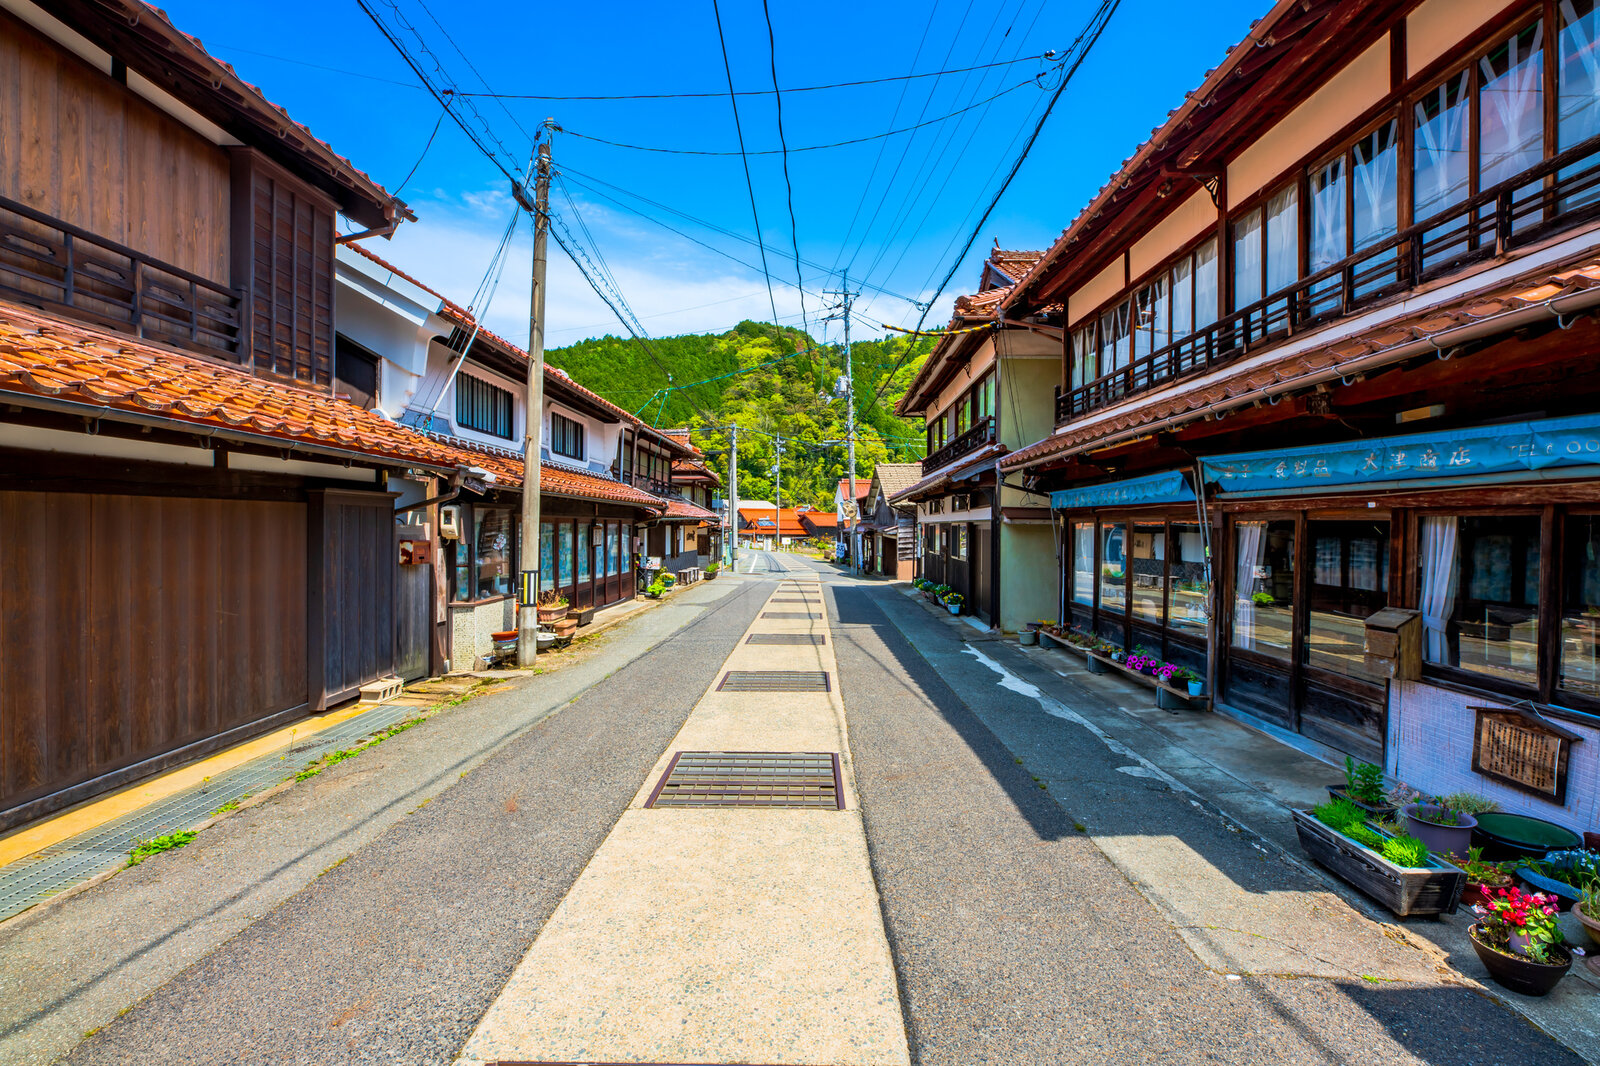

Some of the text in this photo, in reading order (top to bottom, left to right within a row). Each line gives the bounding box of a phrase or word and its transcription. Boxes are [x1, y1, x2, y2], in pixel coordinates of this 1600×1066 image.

[1363, 446, 1471, 471] 大津商店
[1505, 443, 1539, 457] TEL
